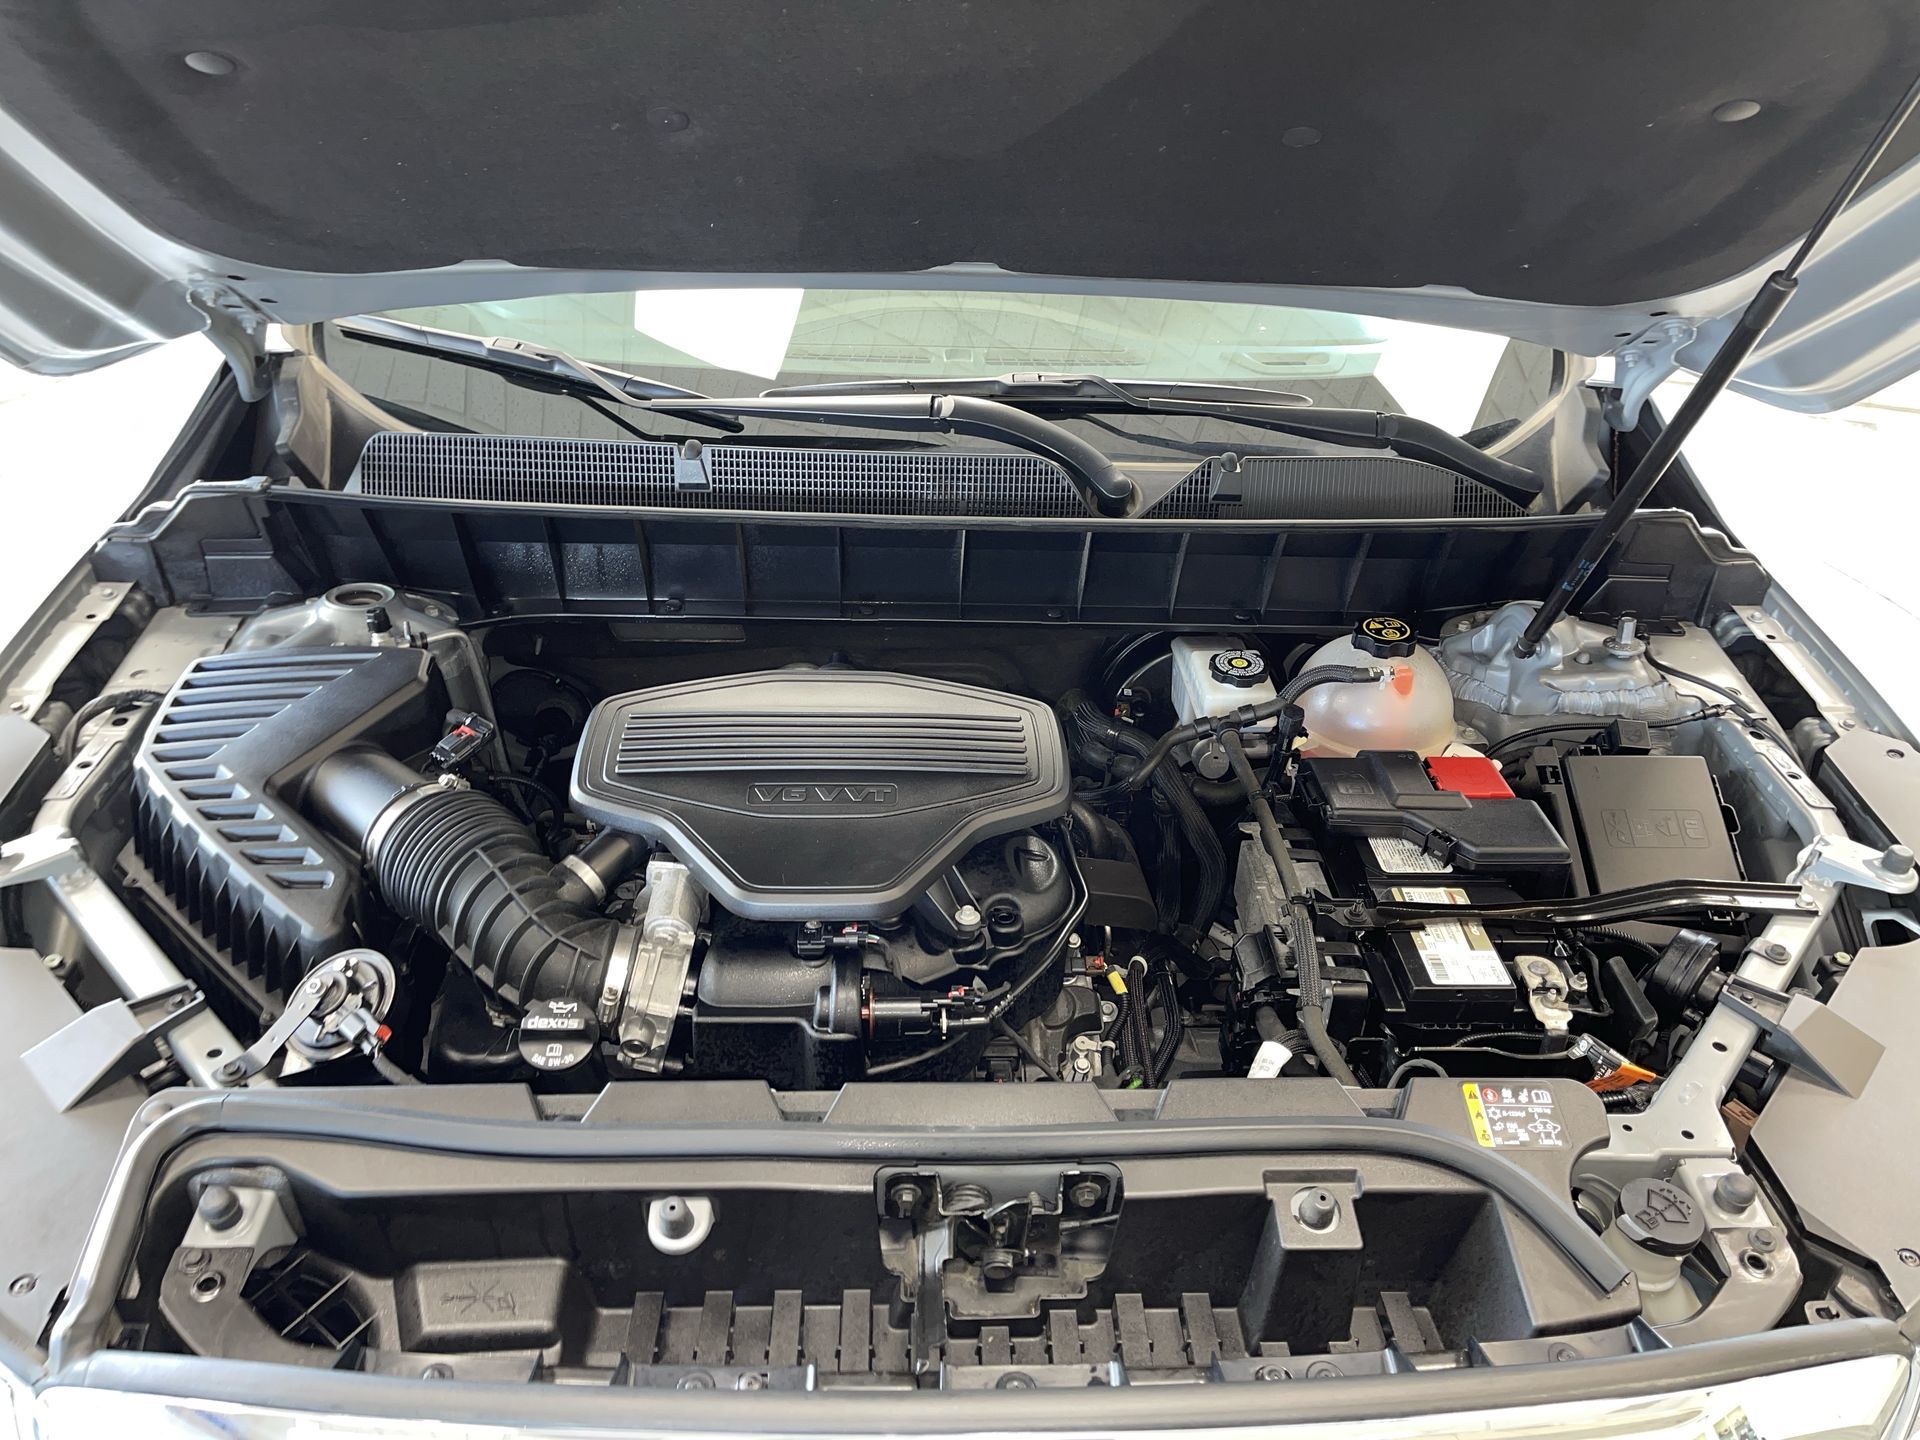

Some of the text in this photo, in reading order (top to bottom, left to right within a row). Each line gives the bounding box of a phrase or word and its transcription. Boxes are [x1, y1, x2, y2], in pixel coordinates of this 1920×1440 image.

[754, 787, 892, 802] V6 VVT
[527, 1016, 578, 1029] dexos
[531, 1053, 546, 1067] SAE
